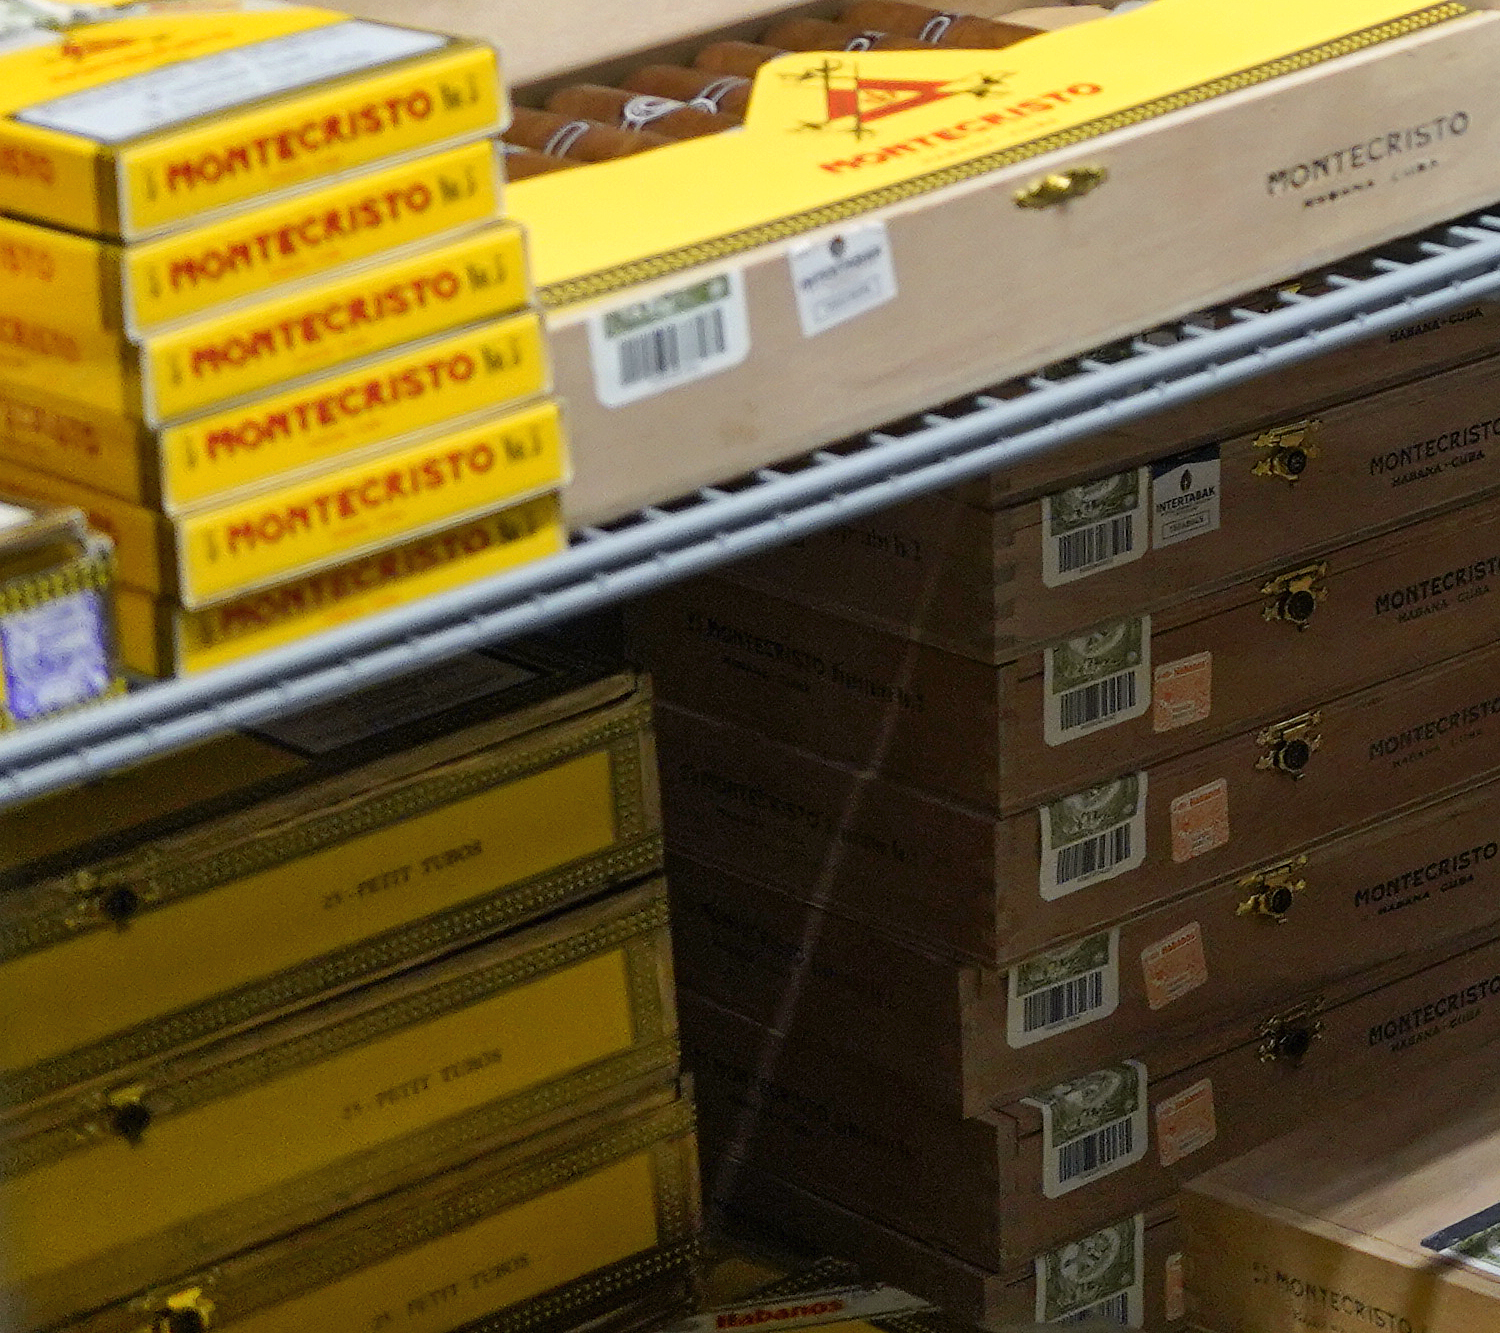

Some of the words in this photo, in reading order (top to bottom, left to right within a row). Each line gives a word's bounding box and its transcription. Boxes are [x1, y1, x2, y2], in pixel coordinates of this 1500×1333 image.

[166, 88, 432, 195] MONTECRISTO
[818, 81, 1104, 176] MONTECRISTO
[1267, 109, 1471, 198] MONTECRISTO
[169, 182, 432, 292] MONTECRISTO
[190, 268, 461, 379] MONTECRISTO
[205, 353, 476, 462] MONTECRISTO
[226, 443, 497, 555] MONTECRISTO
[1155, 484, 1218, 515] INTERTABAK
[1353, 842, 1499, 909] MONTECRISTO
